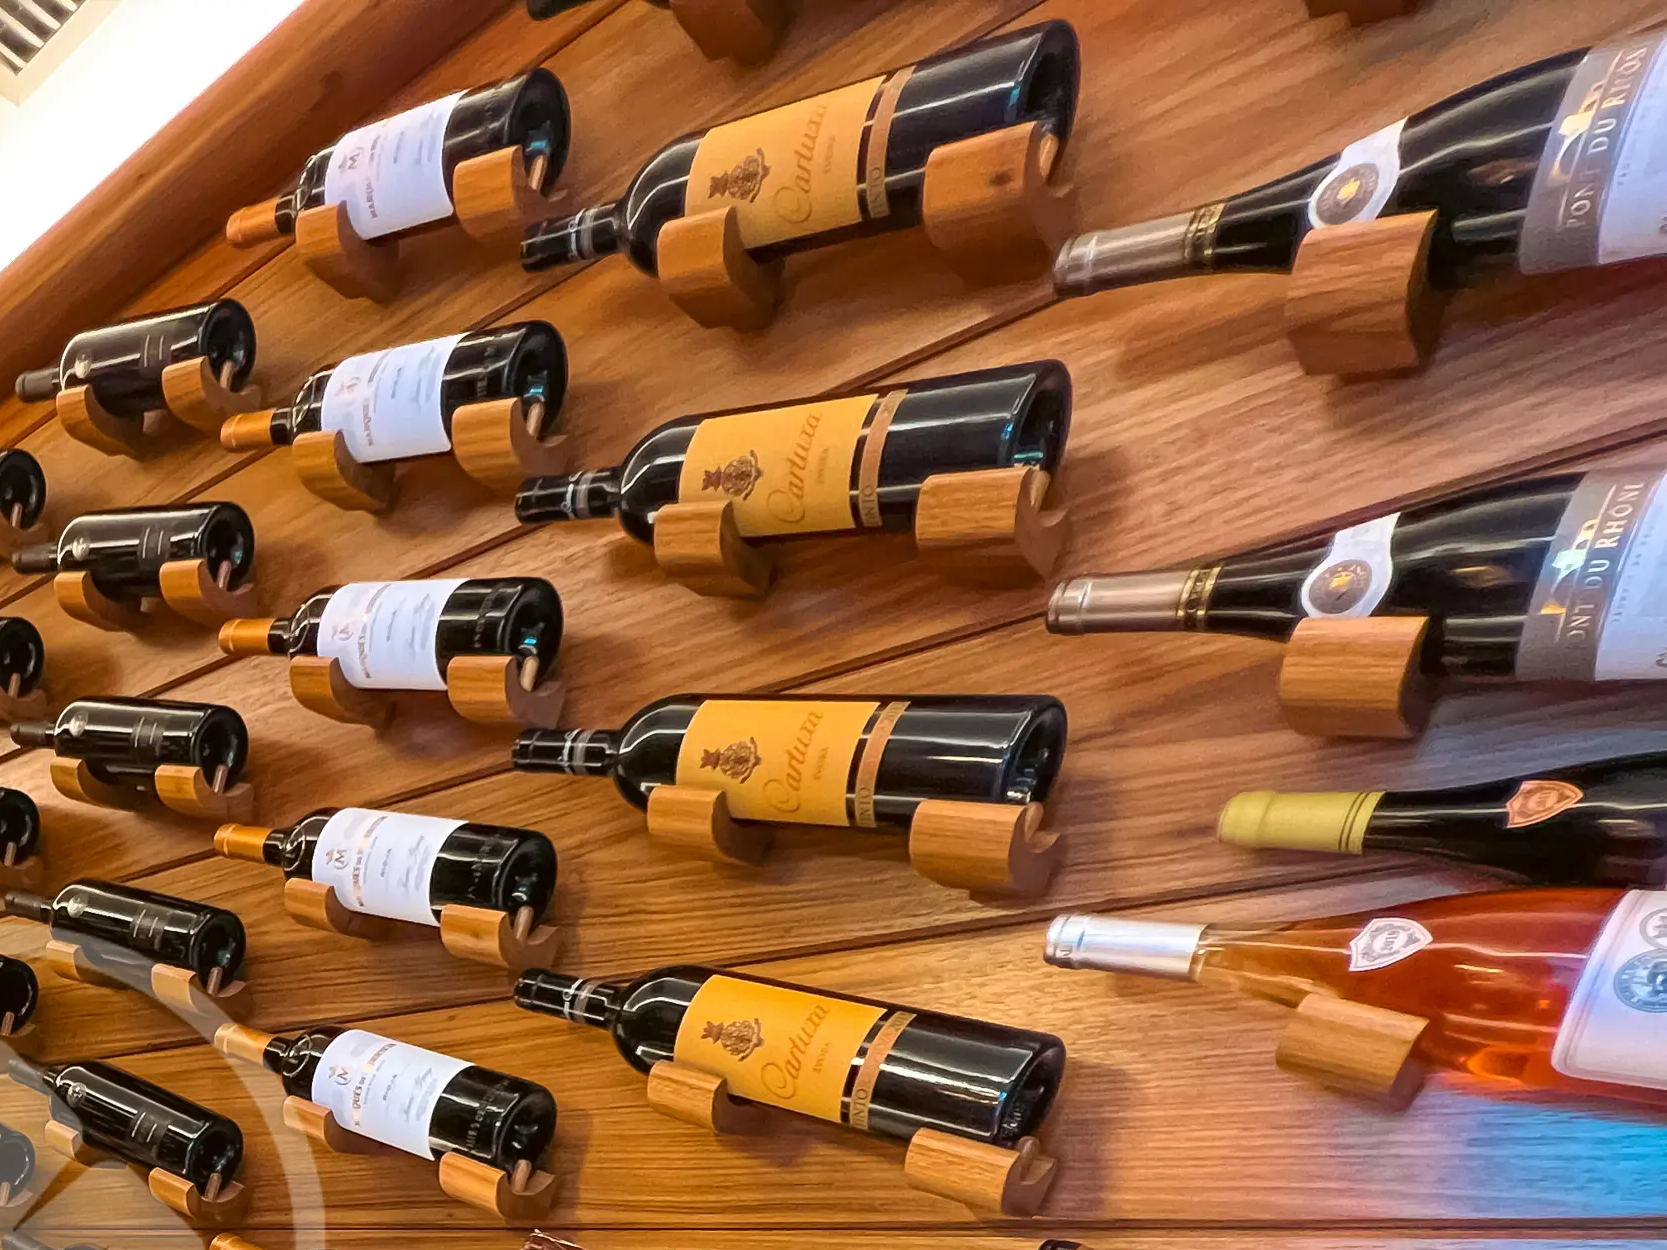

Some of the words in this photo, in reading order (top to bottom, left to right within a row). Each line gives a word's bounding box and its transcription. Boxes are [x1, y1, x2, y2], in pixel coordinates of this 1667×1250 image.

[1587, 116, 1618, 156] DU
[766, 411, 823, 524] Cartuxa
[1566, 602, 1596, 642] ONT
[1584, 558, 1611, 591] DU
[761, 709, 824, 814] Cartuxa
[760, 1002, 832, 1100] Cartuxa
